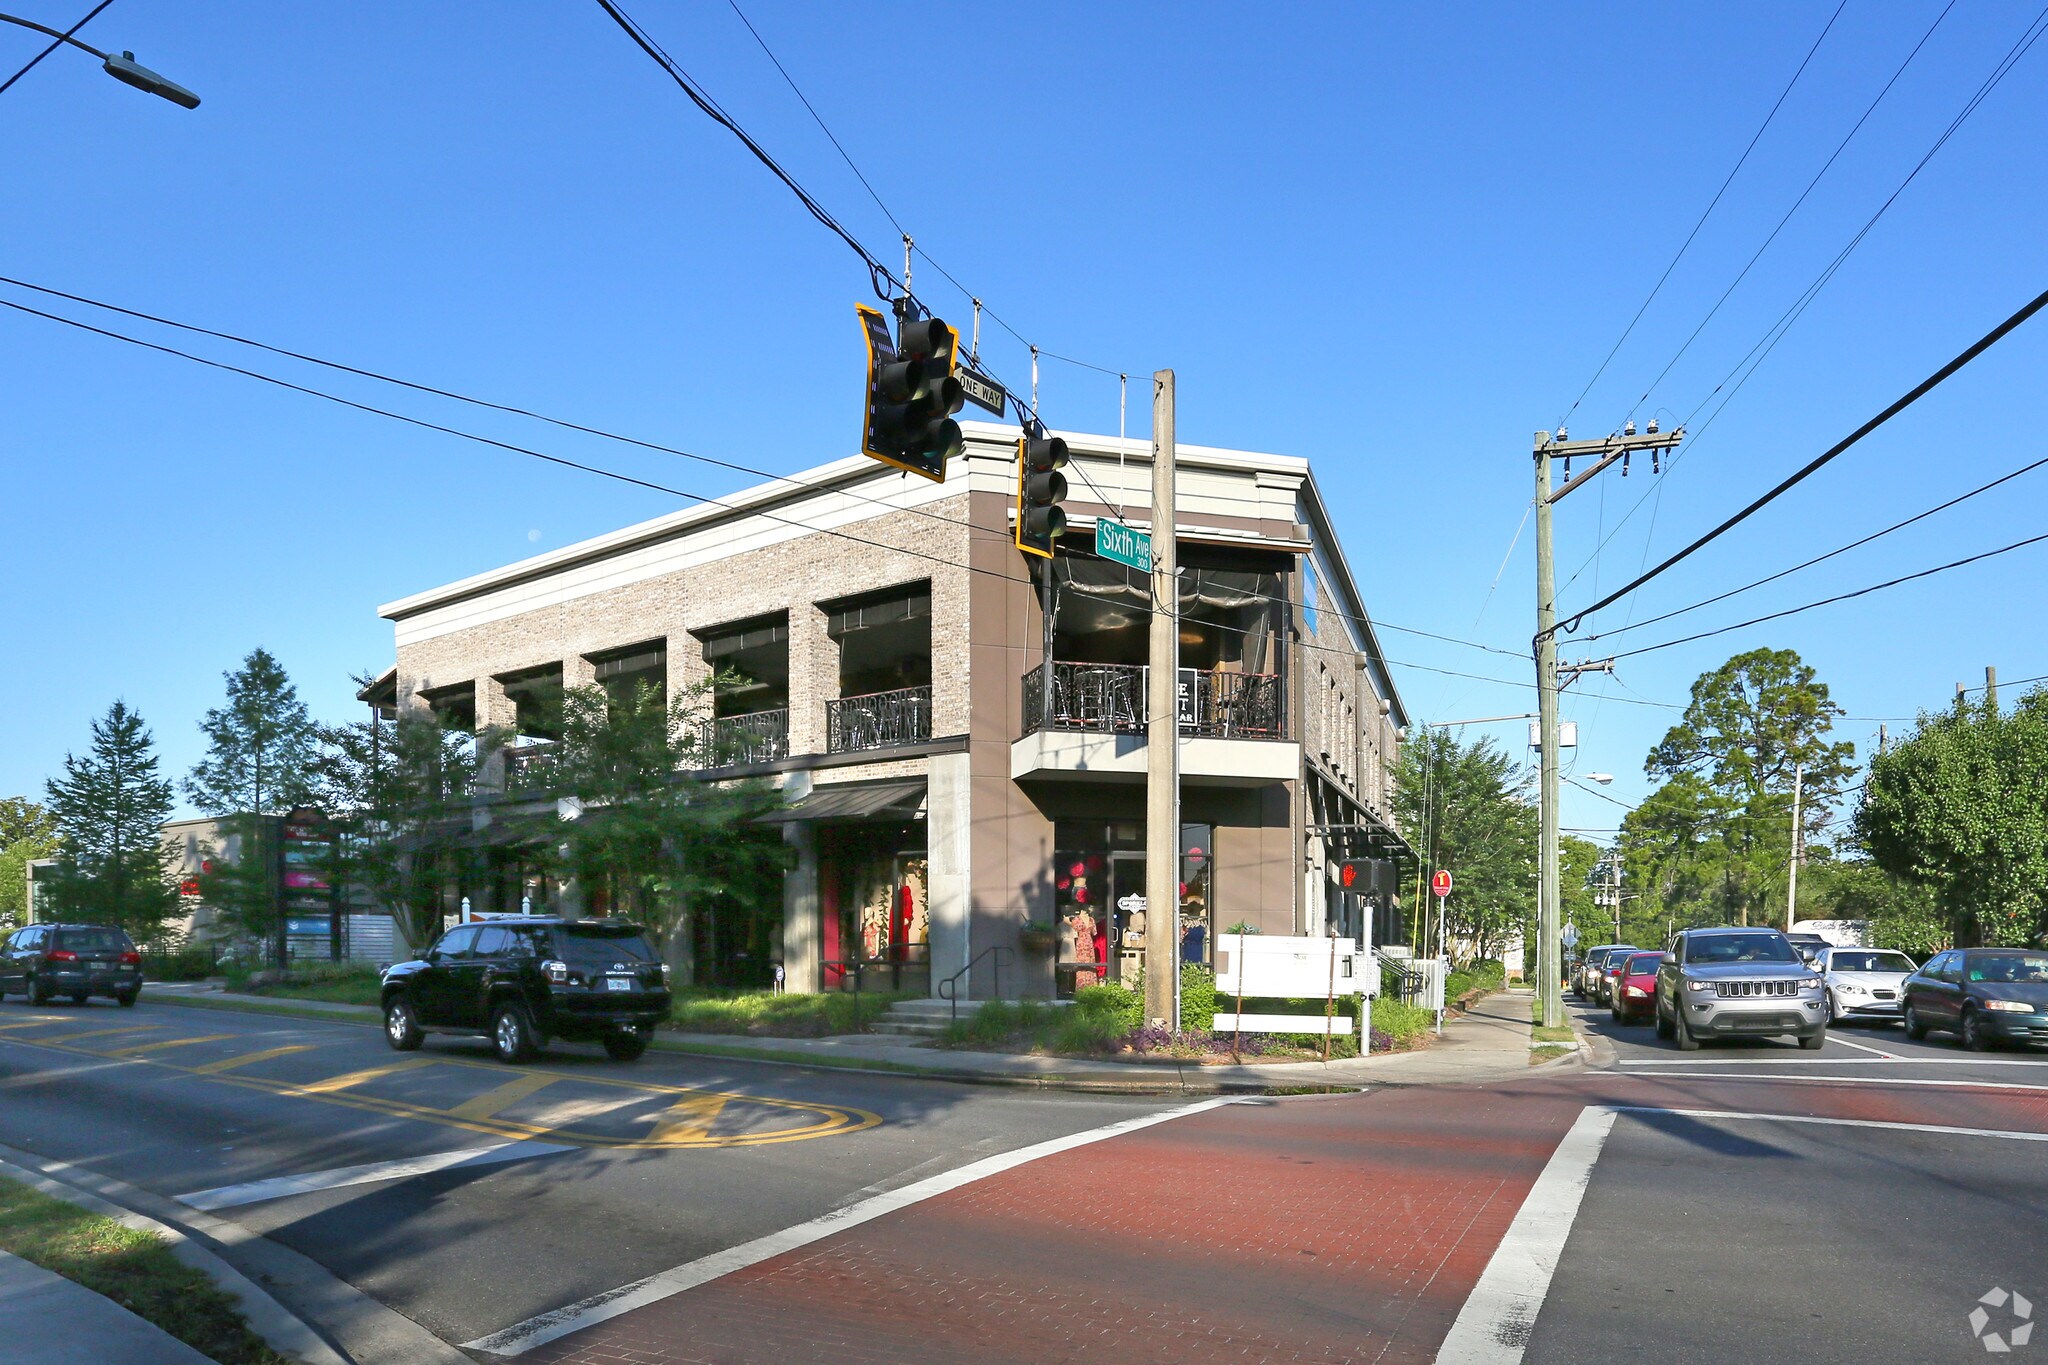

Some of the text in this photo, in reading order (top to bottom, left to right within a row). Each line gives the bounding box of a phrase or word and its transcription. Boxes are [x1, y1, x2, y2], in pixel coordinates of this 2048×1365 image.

[960, 376, 1000, 406] ONE WAY
[1099, 521, 1149, 558] E Sixth Ave
[1136, 556, 1148, 569] 300
